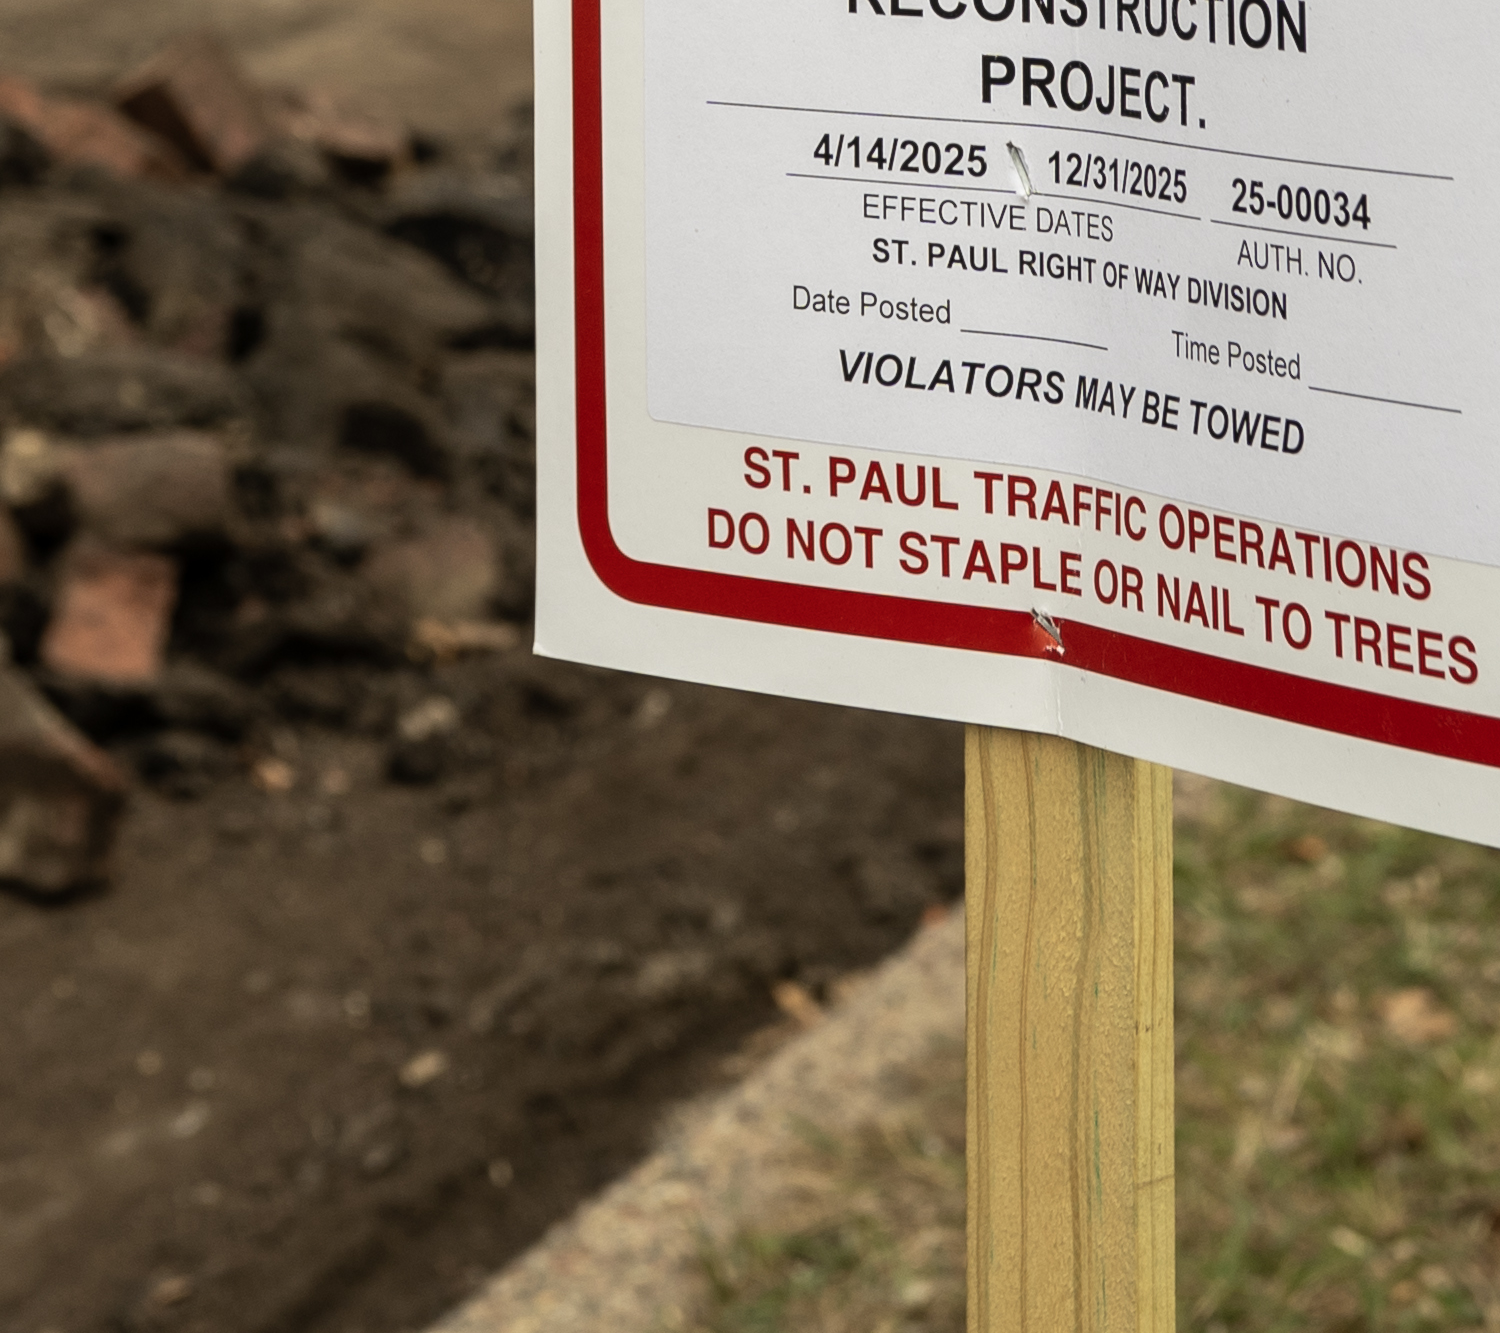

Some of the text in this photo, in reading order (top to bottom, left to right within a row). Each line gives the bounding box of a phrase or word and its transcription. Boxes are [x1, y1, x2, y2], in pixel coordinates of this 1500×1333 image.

[982, 55, 1205, 128] PROJECT.
[814, 134, 1186, 203] 4/14/2025 12/31/2025
[864, 194, 1113, 242] EFFECTIVE DATES
[1231, 177, 1371, 230] 25-00034
[872, 238, 1286, 319] ST. PAUL RIGHT OF WAY DIVISION
[1237, 239, 1362, 284] AUTH. NO.
[794, 285, 950, 324] Date Posted
[1172, 330, 1300, 379] Time Posted
[840, 350, 1304, 454] VIOLATORS MAY BE TOWED
[743, 447, 1432, 601] ST. PAUL TRAFFIC OPERATIONS
[709, 509, 1478, 684] DO NOT STAPLE OR NAIL TO TREES
